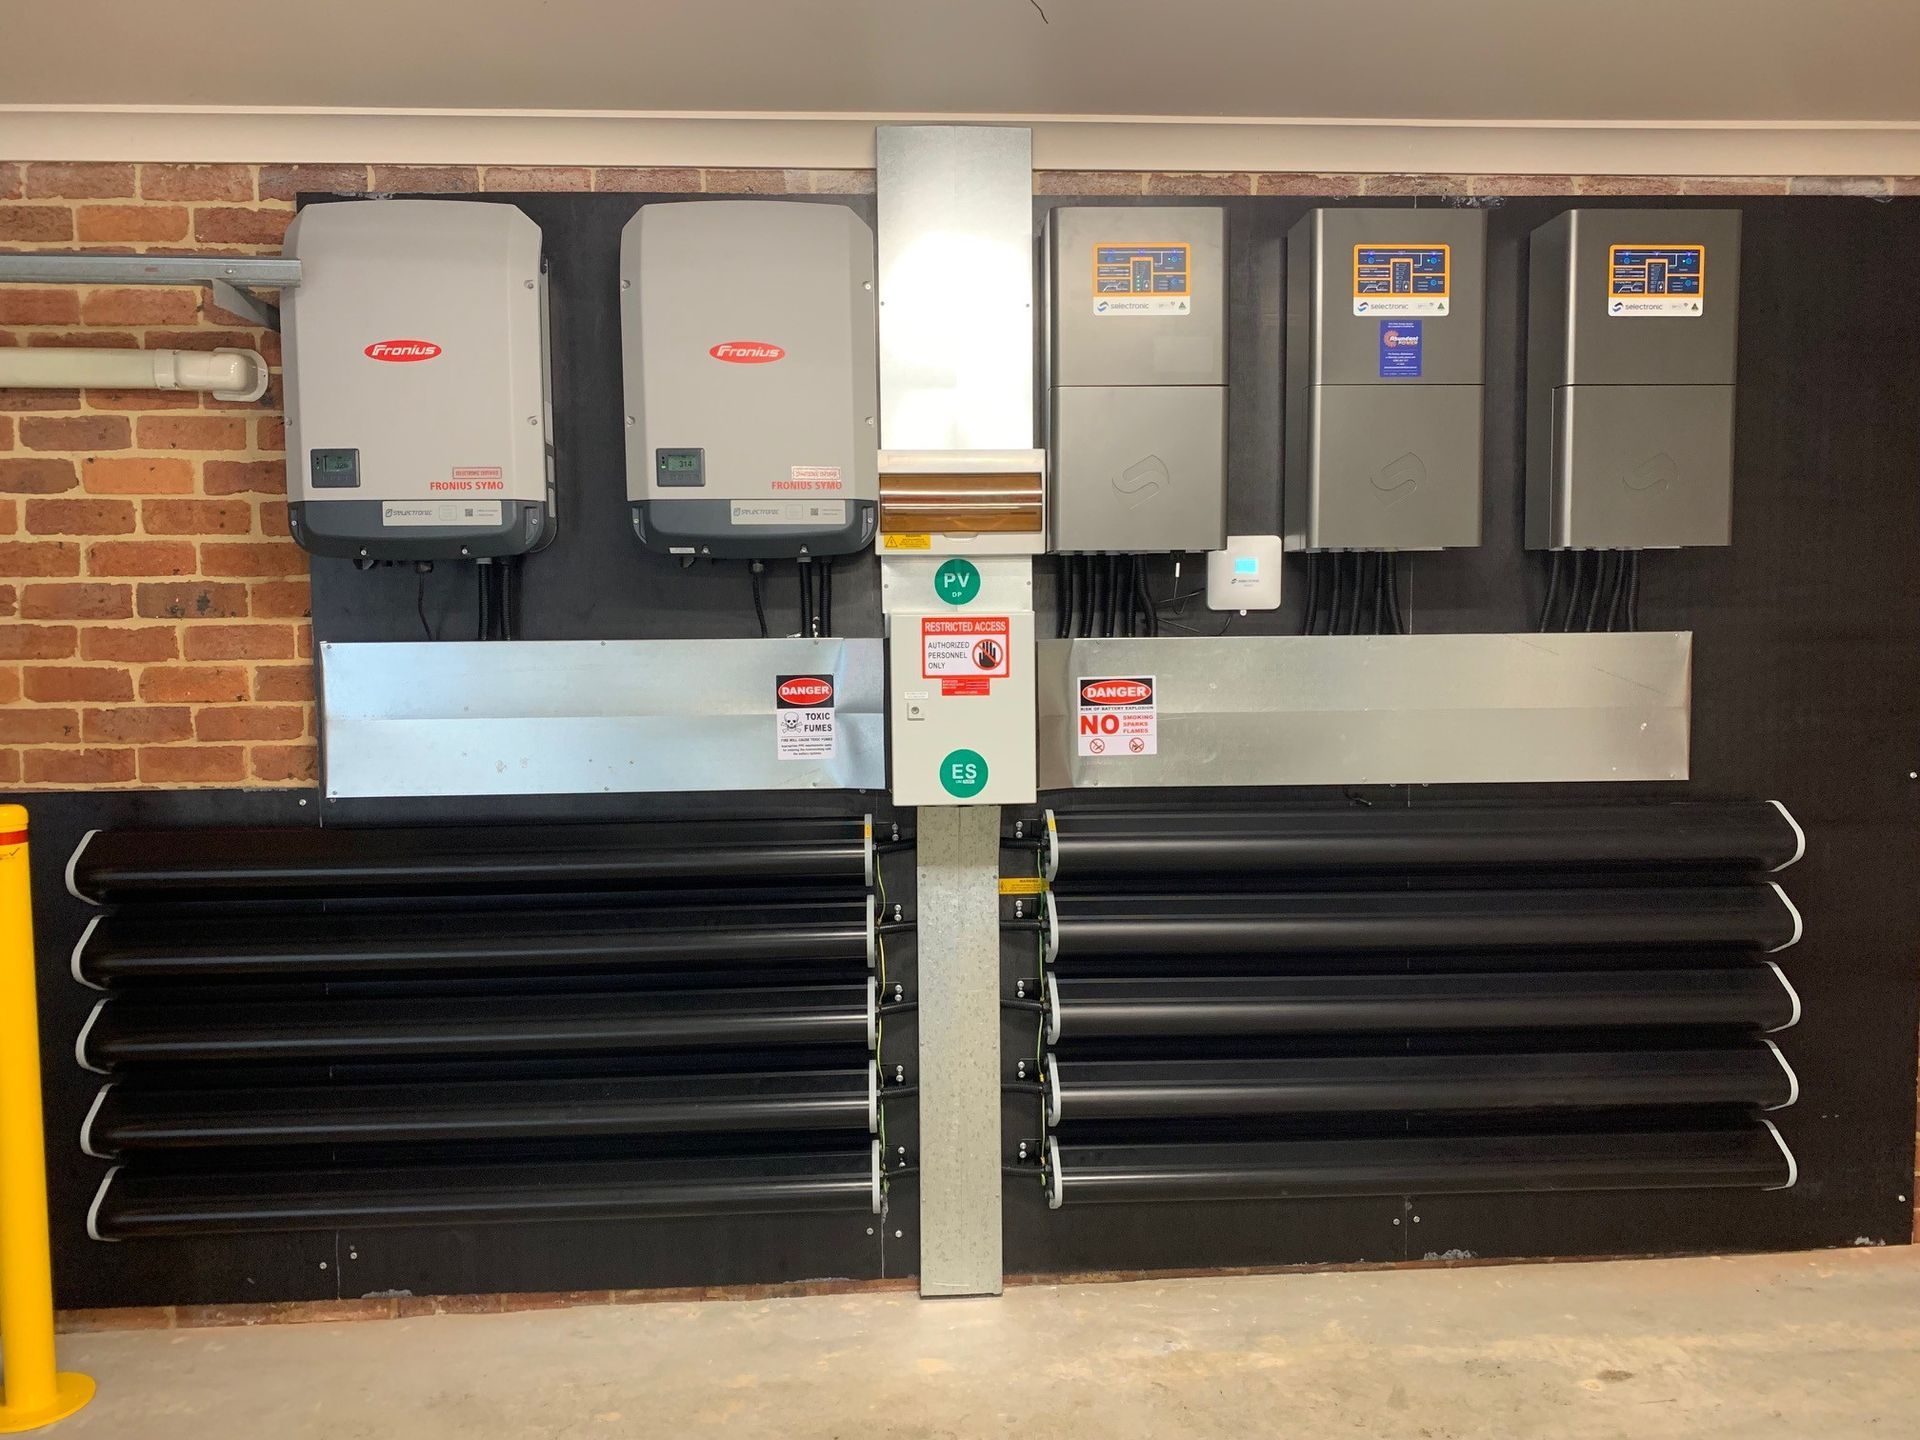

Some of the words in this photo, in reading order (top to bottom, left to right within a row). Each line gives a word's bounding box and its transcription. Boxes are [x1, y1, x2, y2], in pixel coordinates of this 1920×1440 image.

[1370, 302, 1409, 310] selectronic
[372, 344, 437, 356] Fronius
[716, 345, 781, 357] Fronius
[430, 481, 473, 491] FRONIUS
[475, 481, 504, 490] SYMO
[771, 481, 813, 490] FRONIUS
[815, 481, 842, 490] SYMO
[944, 572, 970, 588] PV
[925, 622, 973, 632] RESTRICTED
[975, 621, 1006, 631] ACCESS
[927, 641, 970, 649] AUTHORIZED
[928, 651, 968, 659] PERSONNEL
[782, 686, 829, 695] DANGER
[1087, 687, 1146, 698] DANGER
[804, 724, 833, 732] FUMES
[1080, 714, 1120, 735] NO
[952, 763, 977, 780] ES
